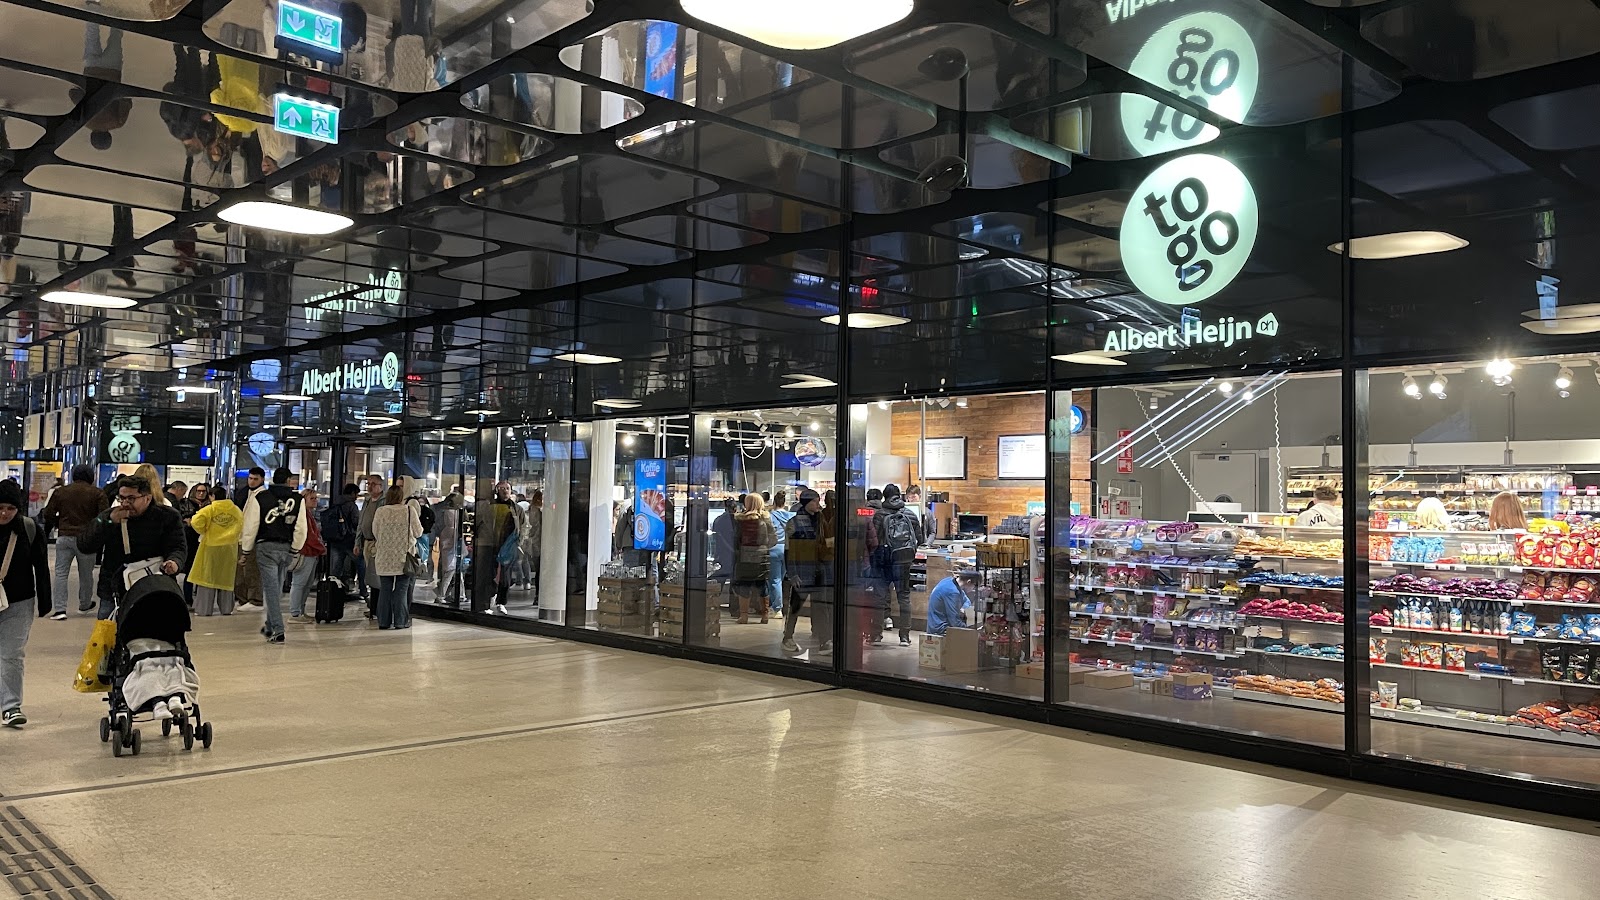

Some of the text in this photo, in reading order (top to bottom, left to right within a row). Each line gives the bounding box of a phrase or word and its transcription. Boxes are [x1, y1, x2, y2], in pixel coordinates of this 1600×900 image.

[1143, 177, 1209, 238] to
[1166, 210, 1240, 292] go
[1103, 325, 1178, 352] Albert
[1184, 316, 1252, 348] Heijn
[300, 358, 381, 396] Albert Heijn
[640, 462, 661, 473] Koffie
